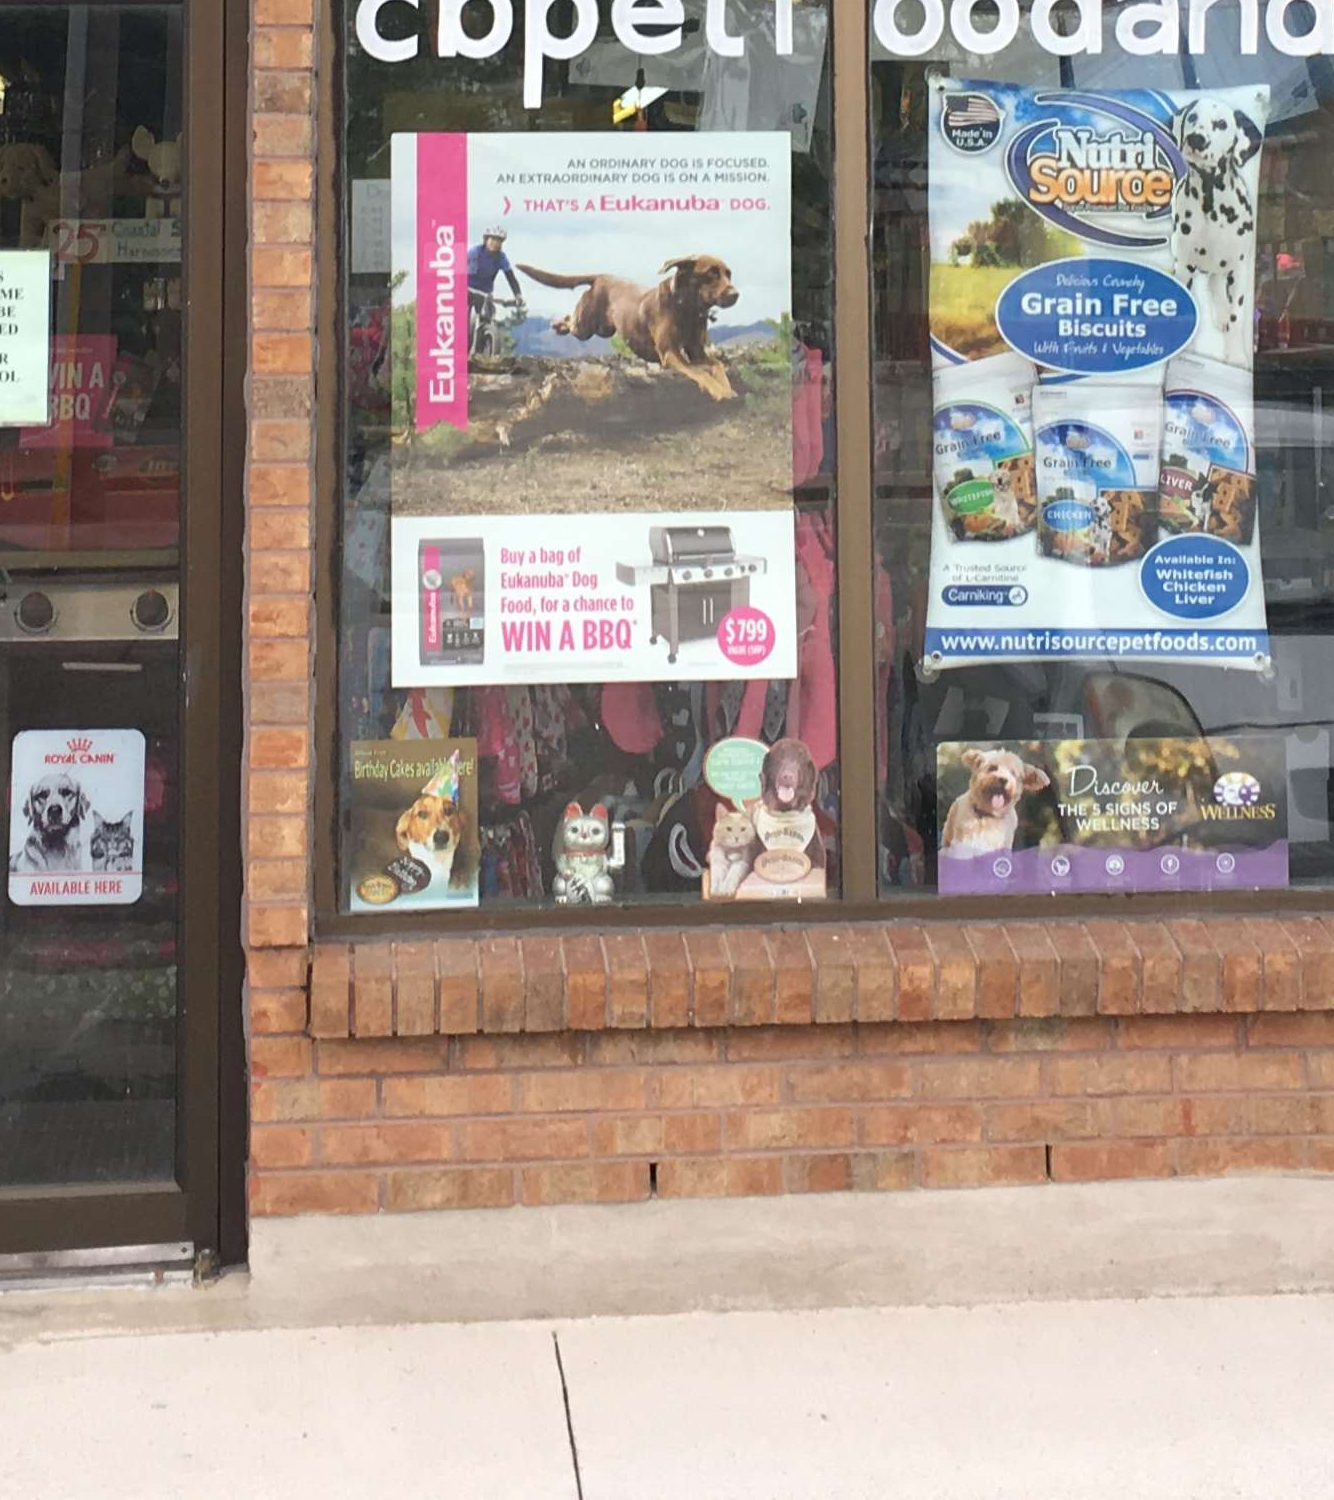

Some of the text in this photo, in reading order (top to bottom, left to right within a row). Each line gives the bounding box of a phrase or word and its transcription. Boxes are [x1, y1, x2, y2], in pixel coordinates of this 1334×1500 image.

[1056, 129, 1156, 170] Nutri
[567, 157, 769, 169] AN ORDINARY DOG IS FOCUSED.
[497, 172, 769, 184] AN EXTRAORDINARY DOG IS ON A MISSION.
[1029, 155, 1173, 205] Source
[523, 195, 770, 212] THAT'S A Eukanuba DOG.
[1021, 292, 1178, 317] Grain Free
[429, 225, 454, 403] Eukanuba
[1058, 319, 1147, 338] Biscuits
[1046, 509, 1093, 521] CHICKEN
[501, 547, 581, 566] Buy a bag of
[1155, 555, 1213, 566] Available
[501, 571, 598, 590] Eukanuba Dog
[1156, 569, 1234, 581] Whitefish
[948, 587, 1005, 604] Carniking
[1163, 581, 1227, 593] Chicken
[501, 596, 634, 615] Food, for a chance to
[1175, 594, 1215, 605] Liver
[502, 621, 551, 652] WIN
[559, 621, 576, 651] A
[725, 619, 768, 643] $799
[941, 631, 1257, 655] www.nutrisourcepetfoods.com
[44, 753, 115, 765] ROYAL CANIN
[354, 759, 414, 782] Birthday Cakes
[1068, 764, 1164, 798] Discover
[1058, 802, 1177, 817] THE 5 SIGNS OF
[1199, 803, 1277, 821] WELLNESS
[1076, 817, 1160, 831] WELLNESS
[30, 880, 123, 896] AVAILABLE HERE
